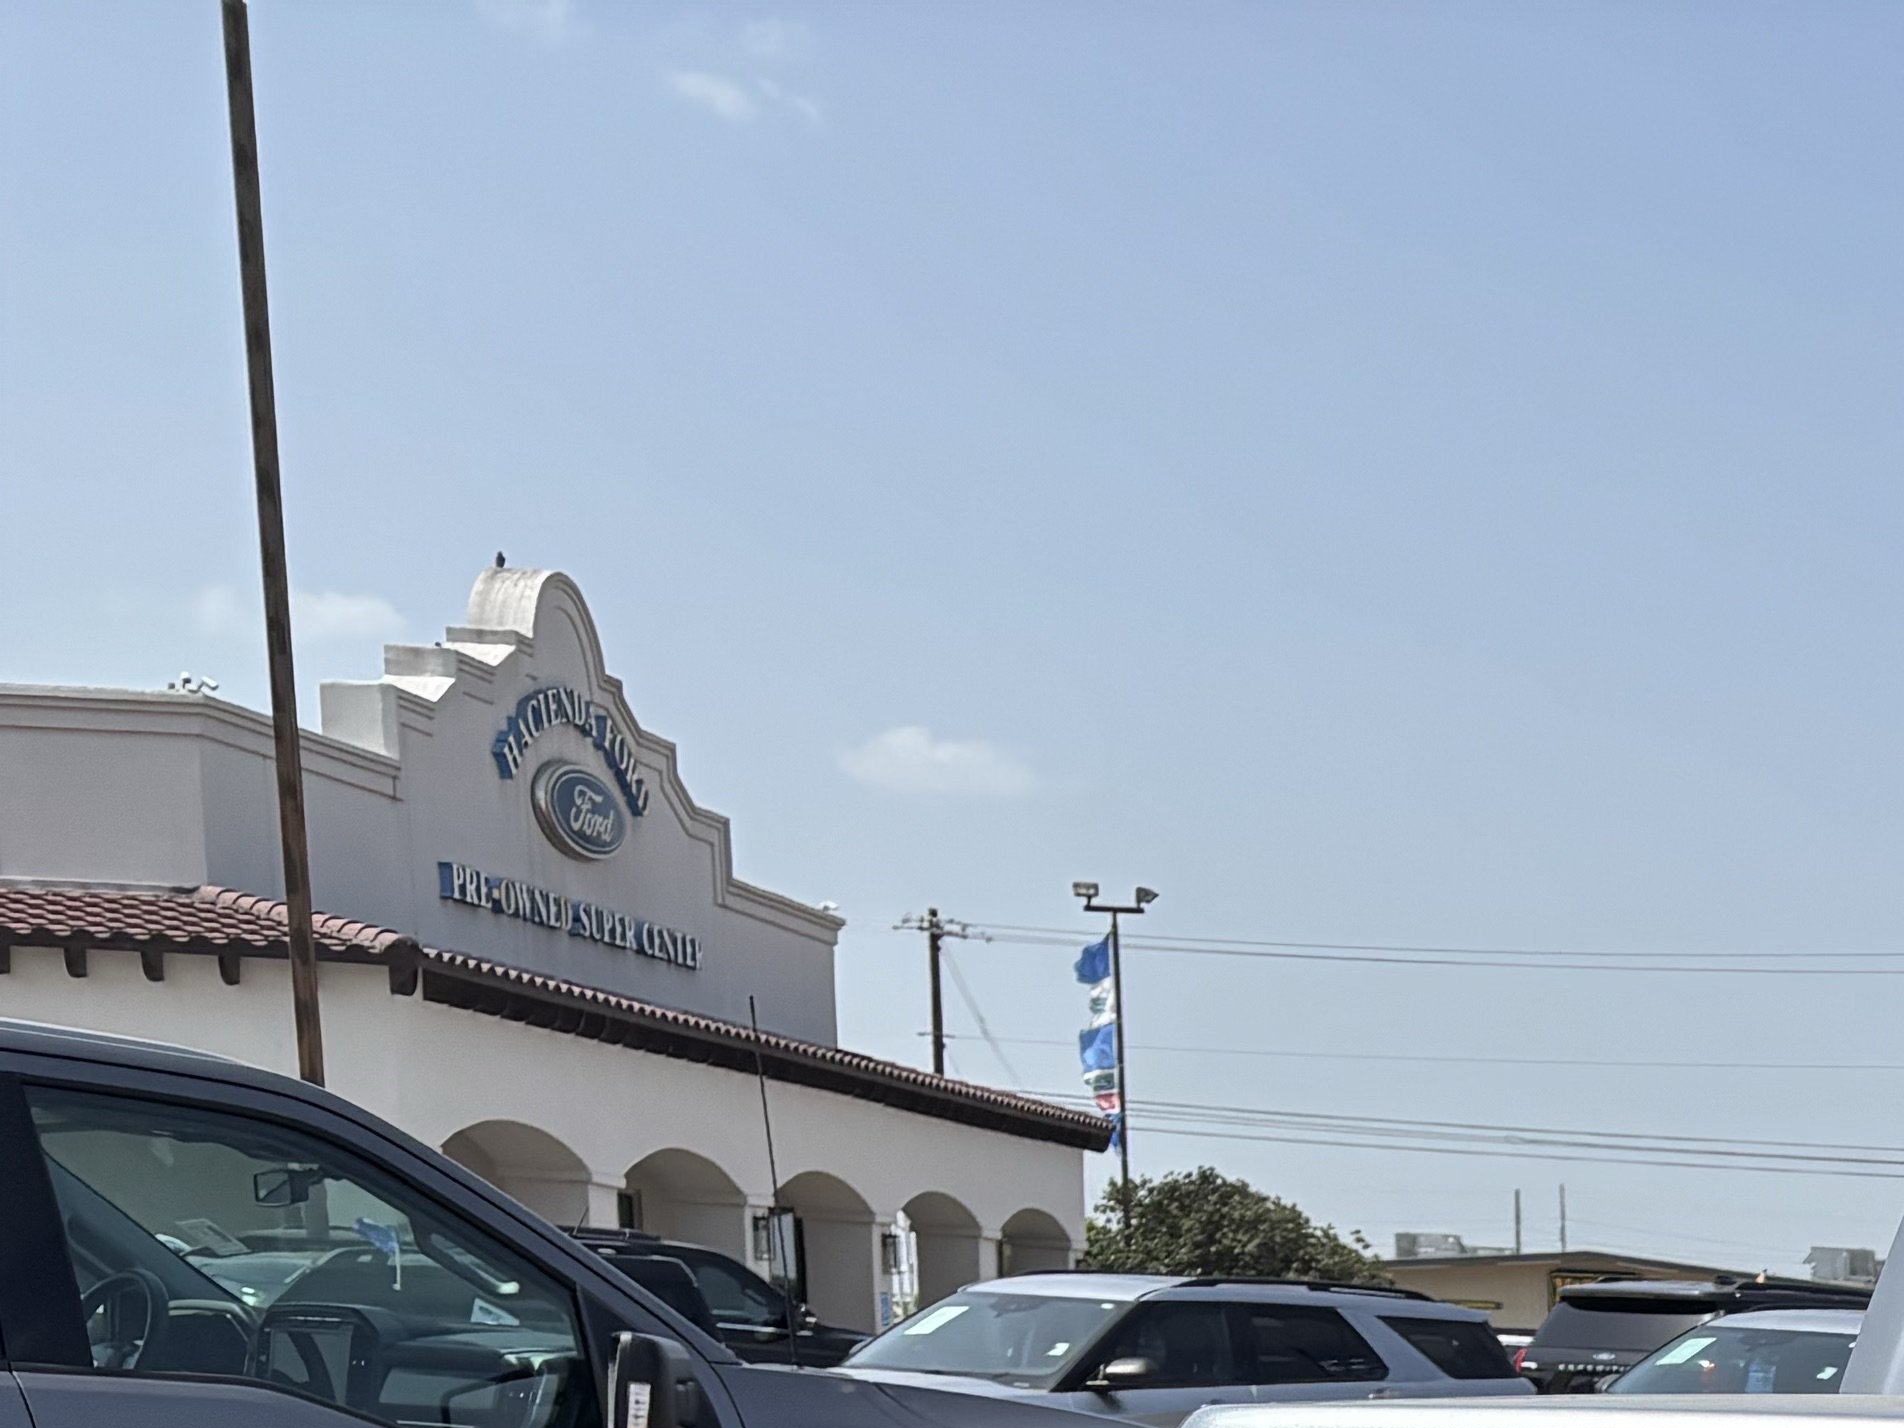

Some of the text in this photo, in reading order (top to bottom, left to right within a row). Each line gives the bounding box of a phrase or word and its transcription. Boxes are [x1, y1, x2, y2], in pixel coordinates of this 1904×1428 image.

[501, 685, 650, 816] HACIENDA FORD
[569, 784, 615, 842] Ford
[451, 863, 703, 971] PRE-OWNED SUPER CENTER
